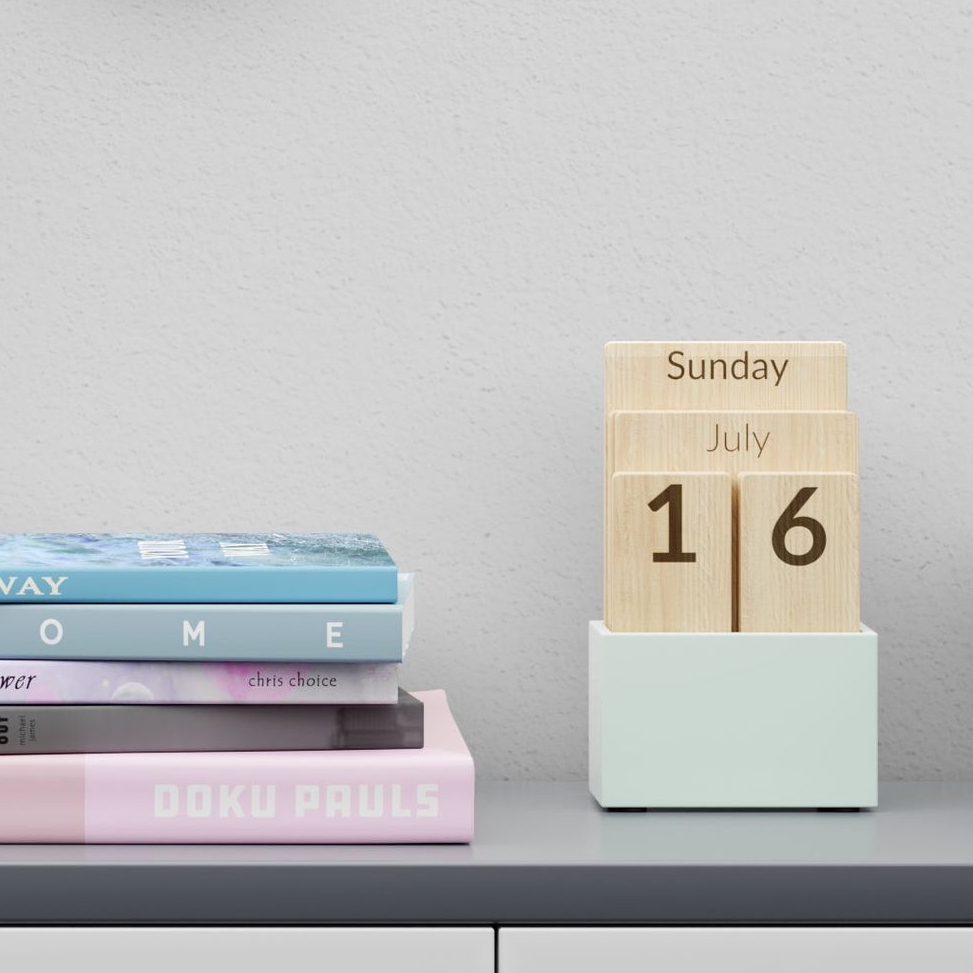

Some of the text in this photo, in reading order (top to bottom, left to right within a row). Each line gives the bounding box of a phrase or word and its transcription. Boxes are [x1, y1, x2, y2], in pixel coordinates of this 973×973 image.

[667, 350, 789, 387] Sunday
[707, 423, 770, 458] July
[248, 671, 338, 688] chris choice
[154, 784, 439, 818] DOKU PAULS
